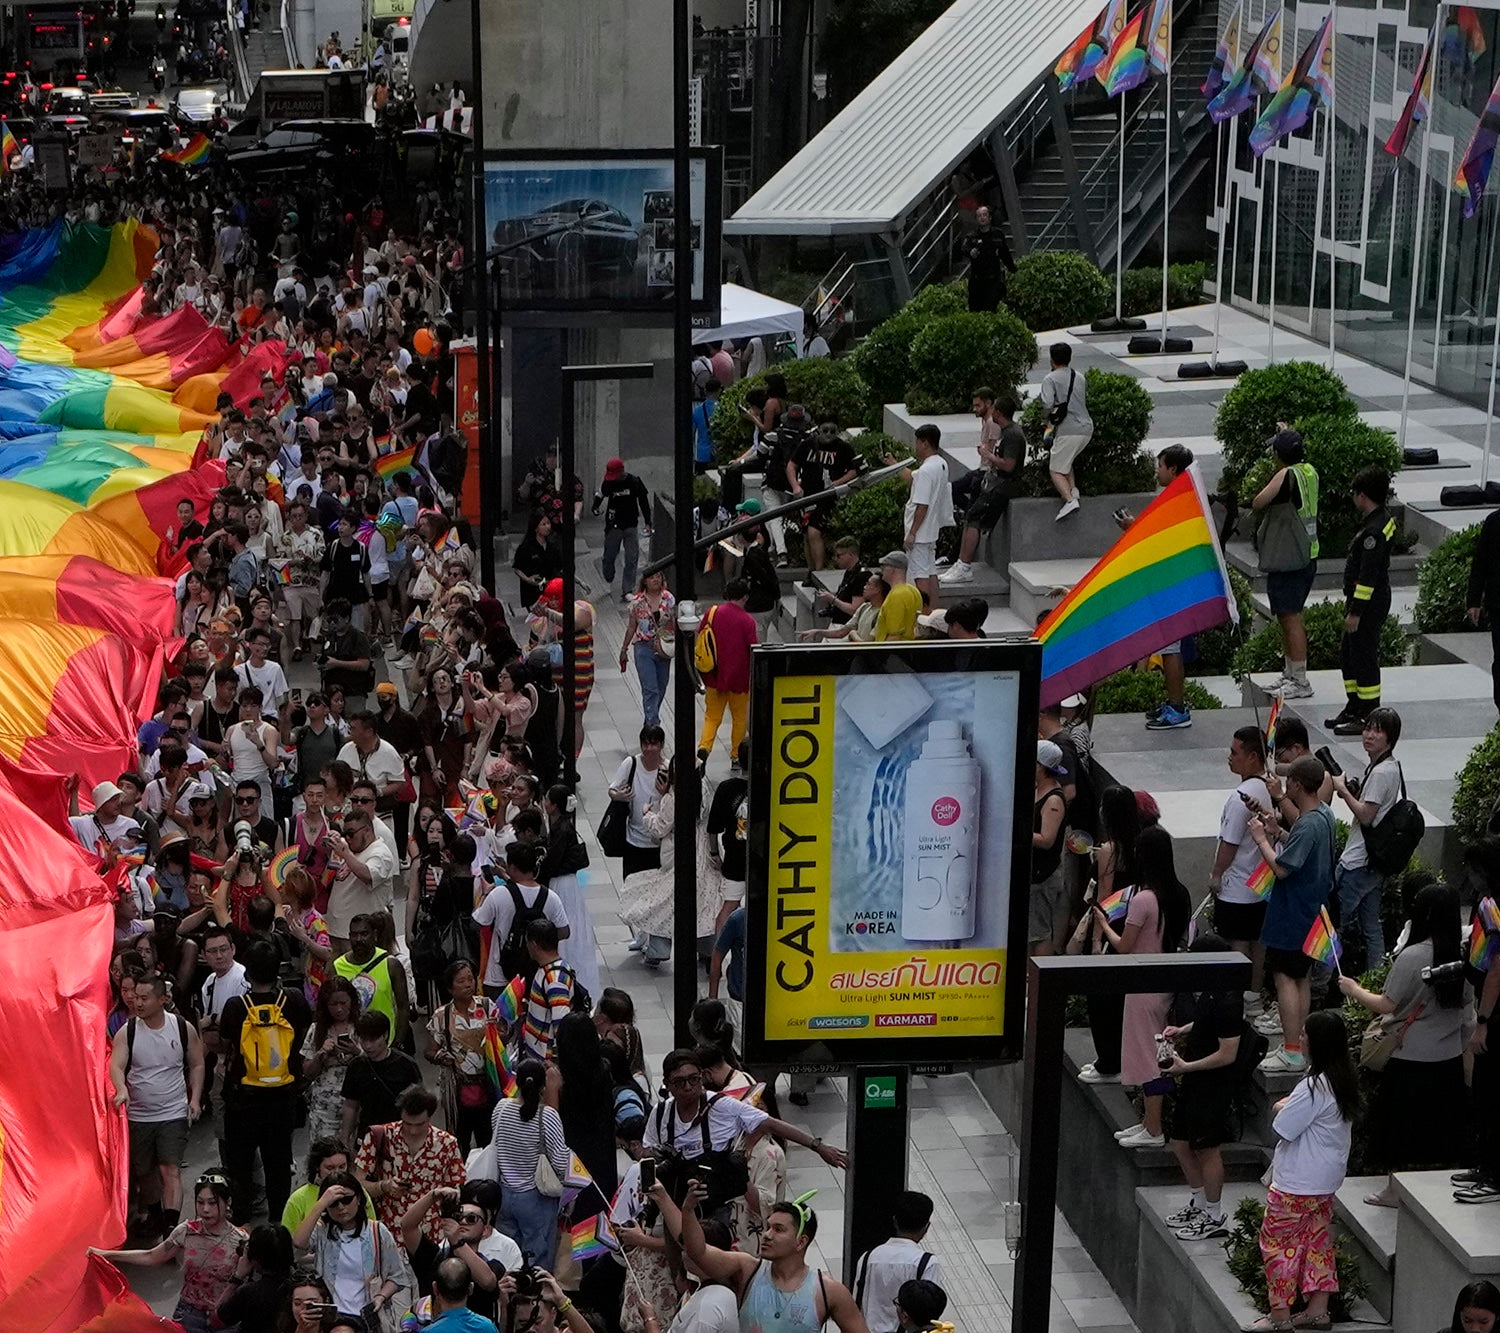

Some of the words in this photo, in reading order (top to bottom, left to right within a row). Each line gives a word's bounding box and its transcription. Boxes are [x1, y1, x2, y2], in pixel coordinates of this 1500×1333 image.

[779, 684, 821, 806] DOLL
[935, 804, 957, 813] Cathy
[937, 811, 954, 820] Doll
[776, 821, 818, 992] CATHY
[854, 911, 884, 920] MADE
[886, 911, 897, 919] IN
[846, 921, 896, 934] KOREA
[829, 957, 1001, 990] สเปรย์กันแดด
[840, 993, 862, 1003] Ultra
[865, 992, 887, 1003] Light
[889, 993, 910, 1001] SUN
[912, 992, 936, 1001] MIST
[815, 1017, 862, 1027] watsons
[879, 1015, 933, 1025] KARMART
